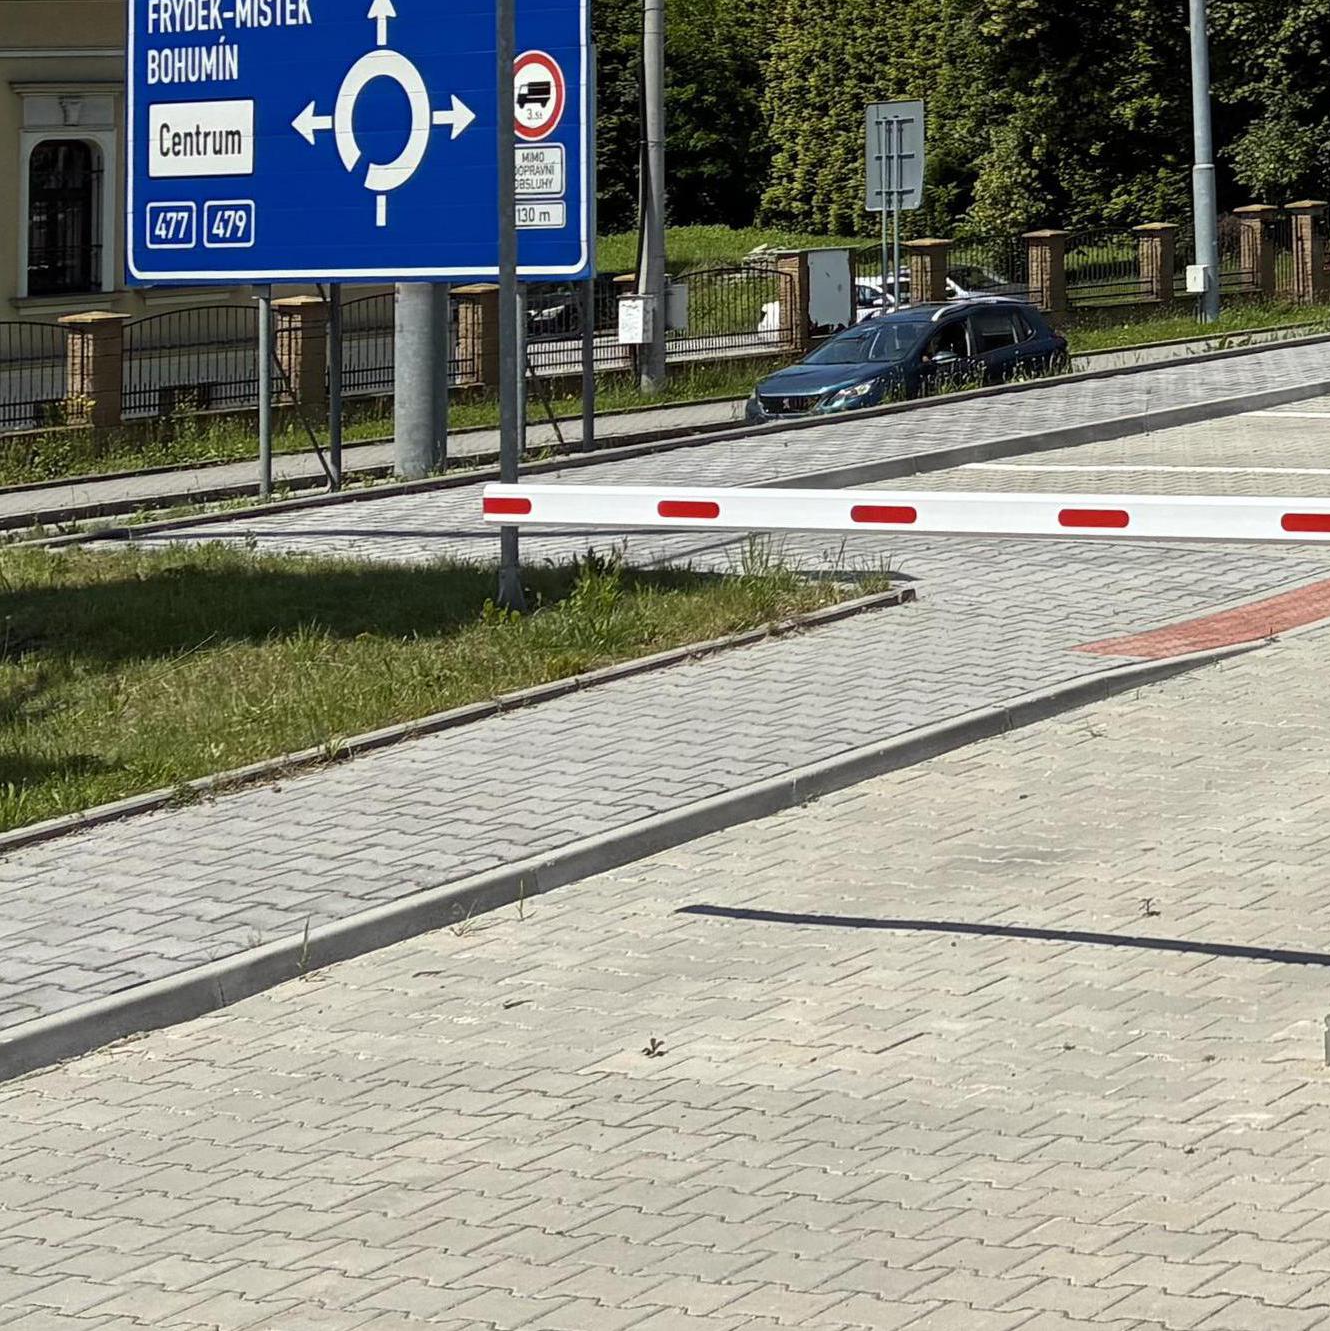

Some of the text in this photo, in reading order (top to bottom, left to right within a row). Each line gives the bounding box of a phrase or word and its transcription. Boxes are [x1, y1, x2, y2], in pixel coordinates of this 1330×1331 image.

[147, 35, 239, 85] BOHUMÍN
[159, 122, 242, 158] Centrum
[521, 151, 545, 163] MIMO
[154, 209, 247, 240] 477 479
[516, 207, 551, 223] 130 m
